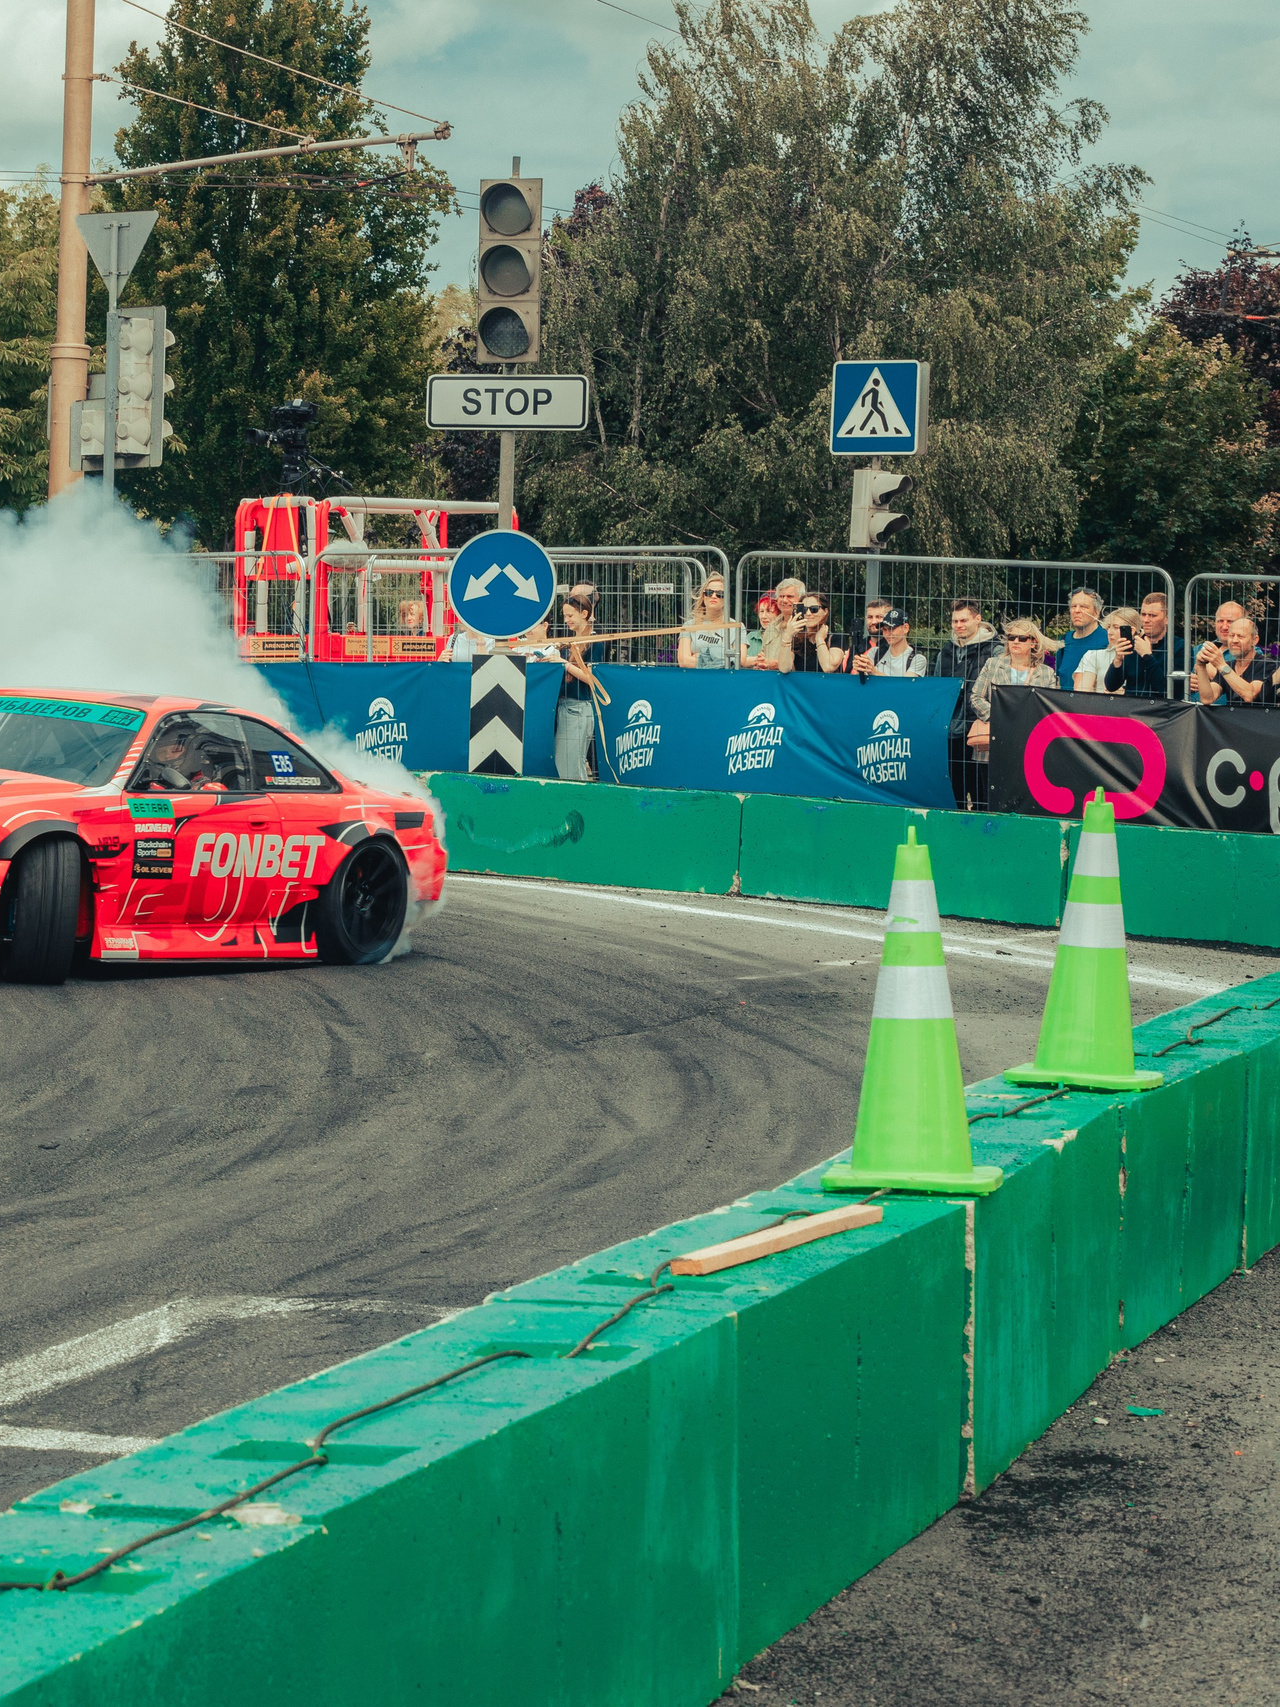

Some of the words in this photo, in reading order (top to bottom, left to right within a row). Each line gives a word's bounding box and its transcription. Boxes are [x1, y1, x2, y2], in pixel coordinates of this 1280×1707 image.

[461, 388, 552, 416] STOP
[697, 634, 720, 645] PUMA
[355, 722, 408, 753] ЛИМОНАД
[615, 724, 661, 757] ЛИМОНАД
[725, 726, 784, 757] ЛИМОНАД
[271, 754, 294, 773] E85
[619, 747, 654, 776] КАЗБЕГИ
[728, 749, 775, 776] КАЗБЕГИ
[856, 737, 911, 768] ЛИМОНАД
[862, 761, 907, 785] КАЗБЕГИ
[137, 848, 157, 857] Sports
[190, 832, 326, 879] FONBET
[151, 866, 173, 874] SEVEN
